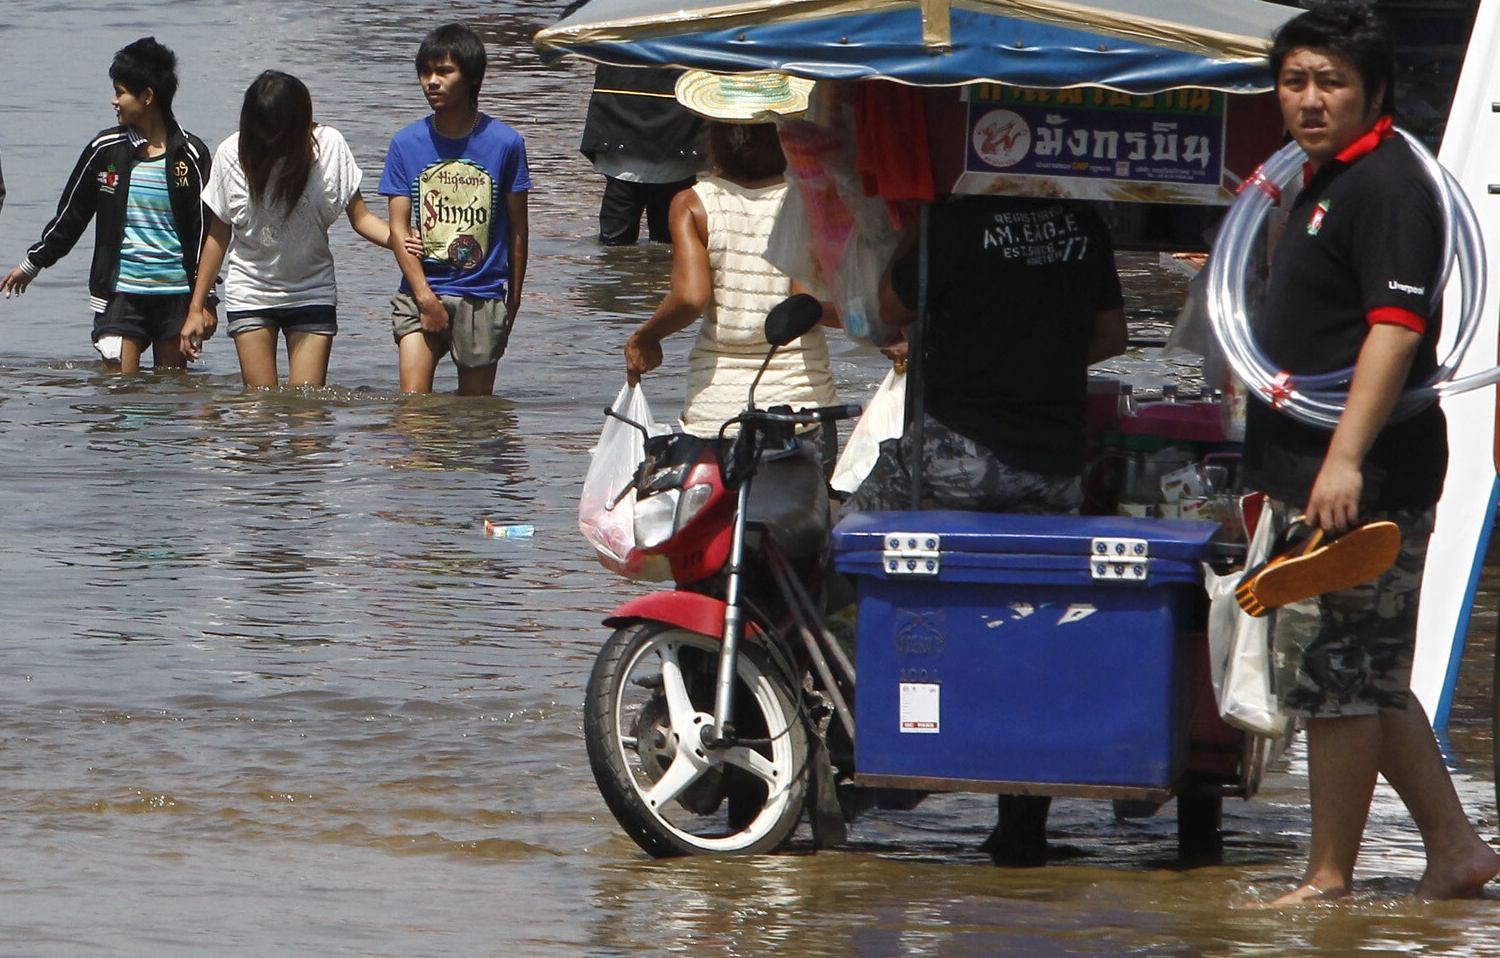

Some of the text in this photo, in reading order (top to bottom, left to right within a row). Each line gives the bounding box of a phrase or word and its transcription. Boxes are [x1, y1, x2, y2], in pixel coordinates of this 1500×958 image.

[1034, 113, 1212, 170] มังกรบิน
[438, 170, 486, 193] Higson's
[423, 189, 488, 233] Stingo
[1387, 279, 1425, 295] Liverpool
